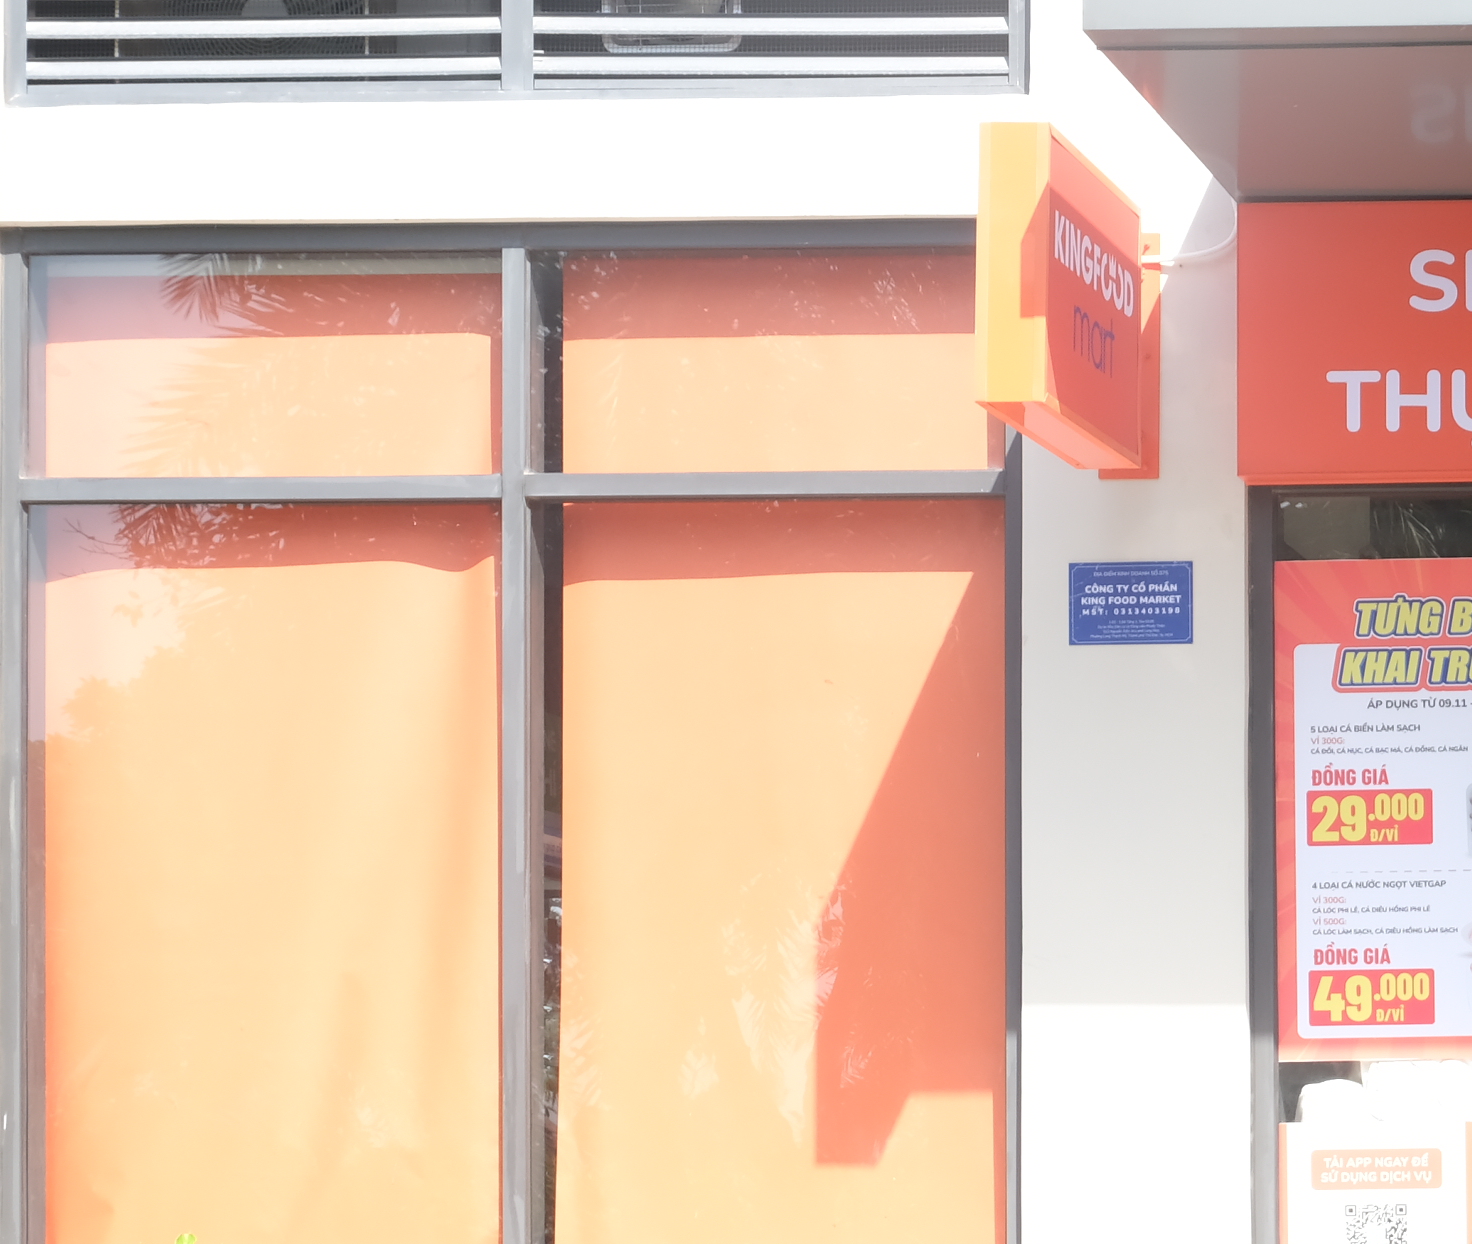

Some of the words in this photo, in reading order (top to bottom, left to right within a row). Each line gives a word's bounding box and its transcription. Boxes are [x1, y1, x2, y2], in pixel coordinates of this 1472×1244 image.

[1053, 208, 1135, 318] KINGFOOD
[1072, 303, 1116, 380] mart
[1085, 583, 1113, 593] CÔNG
[1116, 585, 1129, 593] TY
[1132, 581, 1145, 592] CỔ
[1149, 581, 1177, 592] PHẦN
[1081, 596, 1105, 606] KING
[1108, 596, 1137, 605] FOOD
[1140, 595, 1181, 604] MARKET
[1339, 648, 1421, 686] KHAI
[1367, 697, 1383, 709] ÁP
[1385, 699, 1418, 711] DỤNG
[1421, 696, 1436, 708] TỪ
[1438, 699, 1467, 708] 09.11
[1340, 723, 1352, 732] CÁ
[1311, 762, 1357, 786] ĐỒNG
[1362, 764, 1389, 785] GIÁ
[1341, 880, 1354, 889] CÁ
[1409, 880, 1446, 888] VIETGAP
[1314, 941, 1358, 965] ĐỒNG
[1364, 944, 1390, 964] GIÁ
[1323, 1155, 1343, 1169] TẢI
[1346, 1157, 1371, 1168] APP
[1375, 1157, 1409, 1168] NGAY
[1341, 1172, 1377, 1185] DỤNG
[1380, 1171, 1410, 1184] DỊCH
[1413, 1170, 1432, 1183] VỤ
